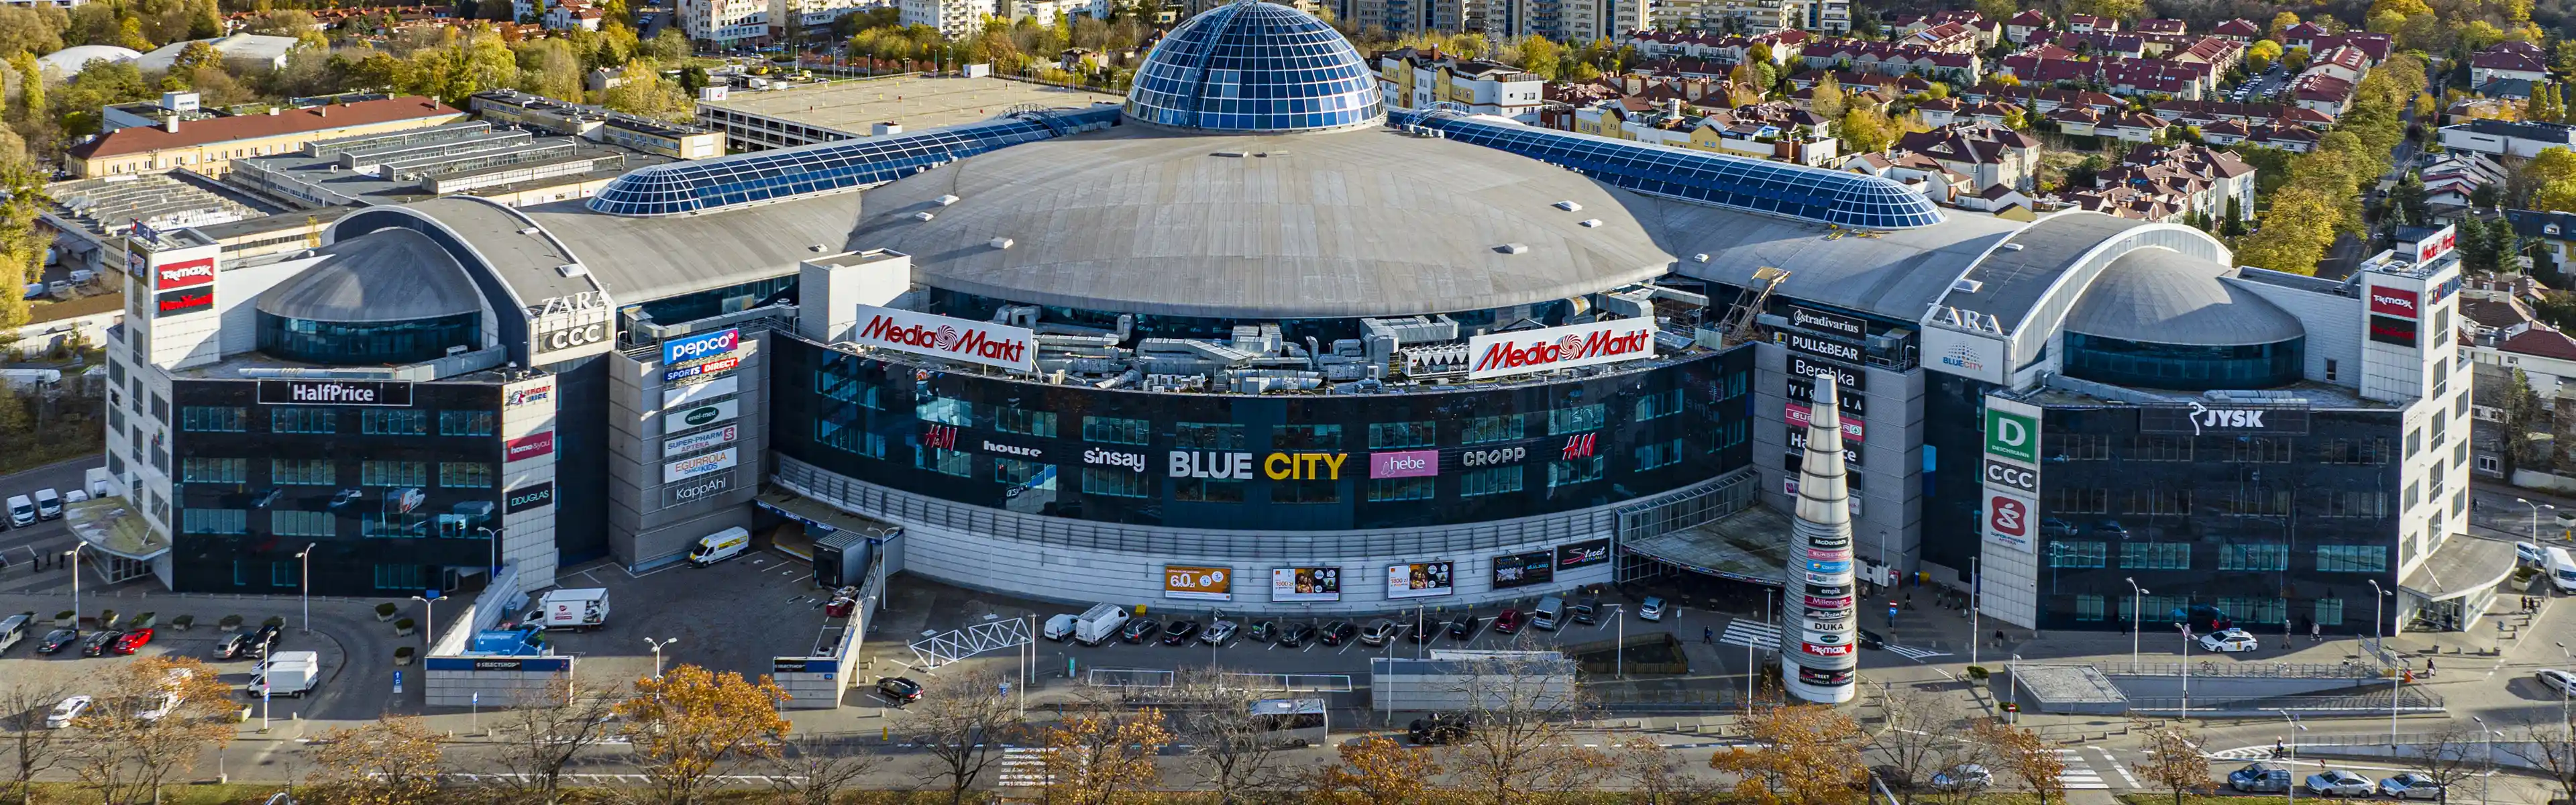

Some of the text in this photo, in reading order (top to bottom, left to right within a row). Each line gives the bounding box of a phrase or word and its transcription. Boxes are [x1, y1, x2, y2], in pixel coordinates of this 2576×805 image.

[542, 289, 614, 317] ZARA
[551, 324, 601, 350] CCC
[673, 335, 729, 360] pepco
[1792, 336, 1858, 360] PULL&BEAR
[667, 358, 735, 380] SPORTS DIRECT
[293, 384, 374, 401] HalfPrice
[688, 410, 716, 421] enel-med
[2204, 410, 2264, 427] JYSK
[668, 431, 722, 449] SUPER-PHARM
[926, 424, 957, 451] H&M
[1998, 417, 2026, 446] D
[682, 441, 710, 452] APTEKA
[983, 441, 1042, 457] house
[1463, 447, 1525, 466] CROPP
[1562, 432, 1595, 460] H&M
[1992, 445, 2030, 458] DEICHMANN
[676, 452, 727, 472] EGURROLA
[1083, 447, 1145, 472] sinsay
[1169, 451, 1348, 480] BLUE CITY
[1391, 456, 1425, 470] hebe
[1988, 464, 2033, 488] CCC
[511, 490, 549, 506] DOUGLAS
[677, 478, 726, 500] KappAhl
[1815, 623, 1843, 631] DUKA
